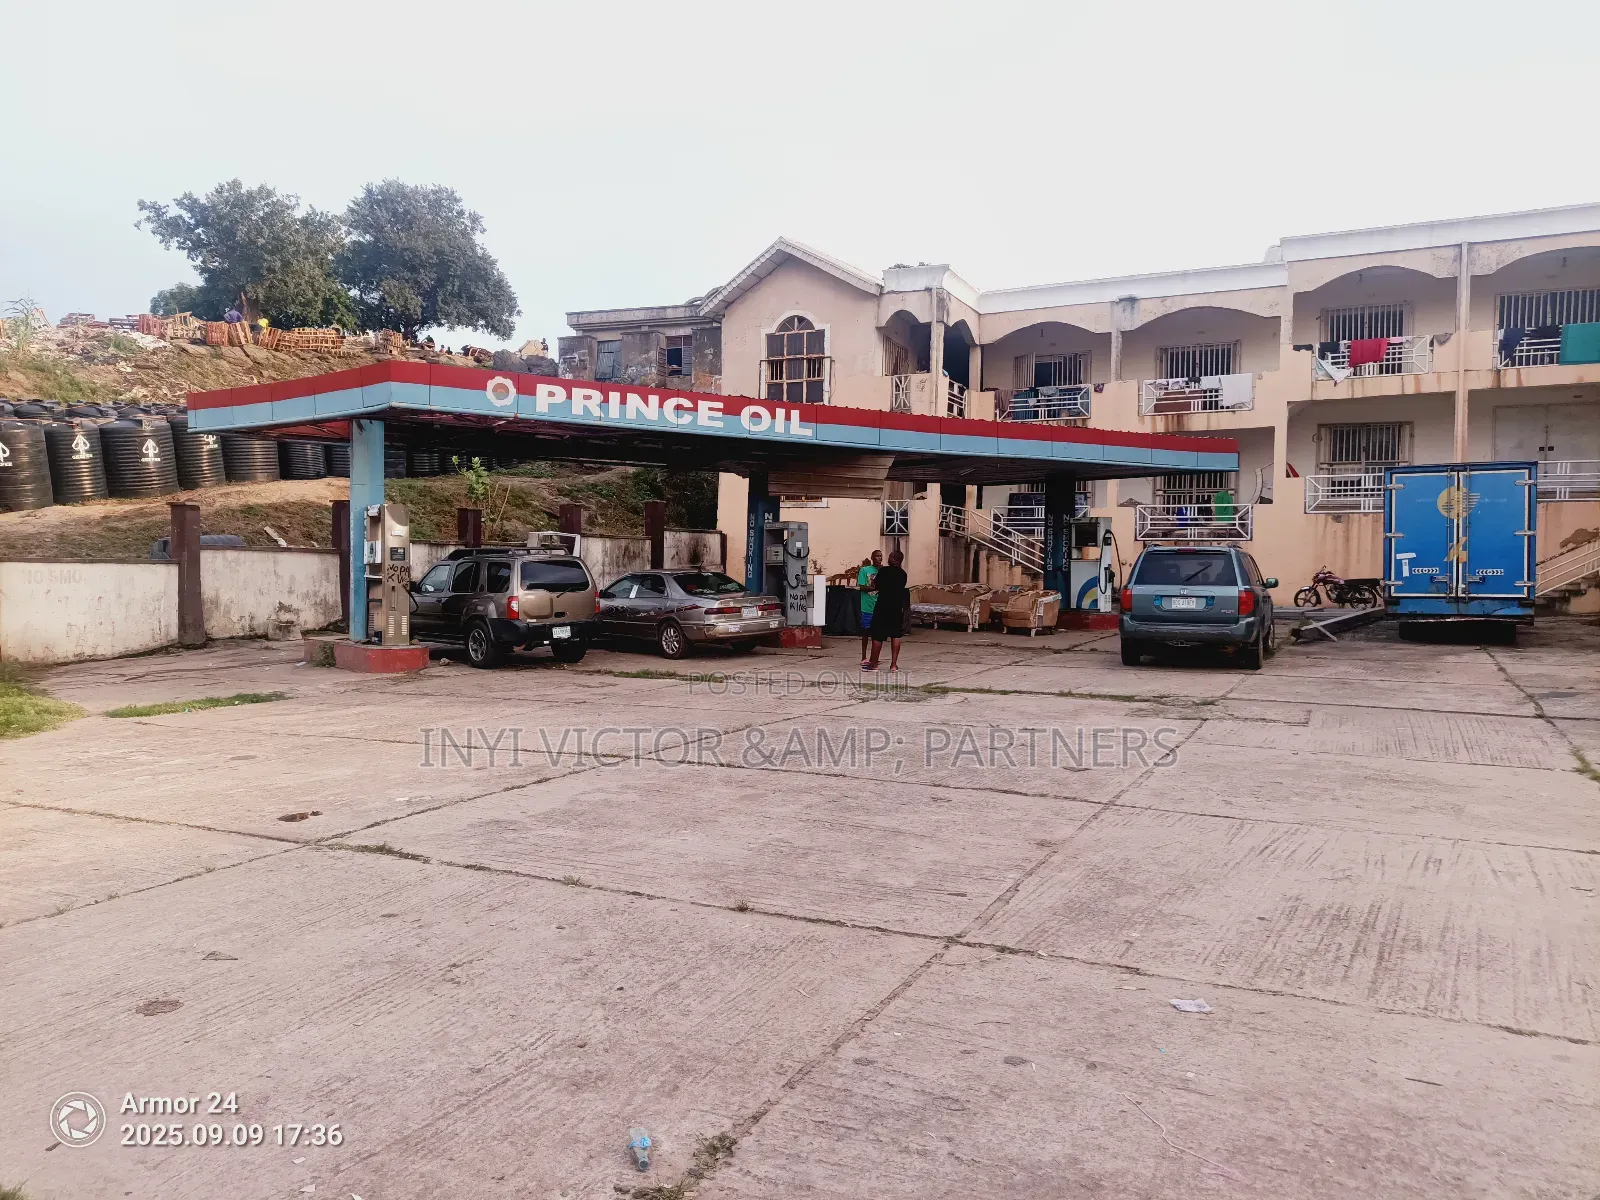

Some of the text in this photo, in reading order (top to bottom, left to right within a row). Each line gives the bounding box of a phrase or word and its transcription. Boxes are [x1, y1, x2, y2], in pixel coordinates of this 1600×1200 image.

[535, 383, 813, 437] PRINCE OIL
[747, 513, 755, 578] NO SMOKING
[1047, 514, 1053, 526] NO
